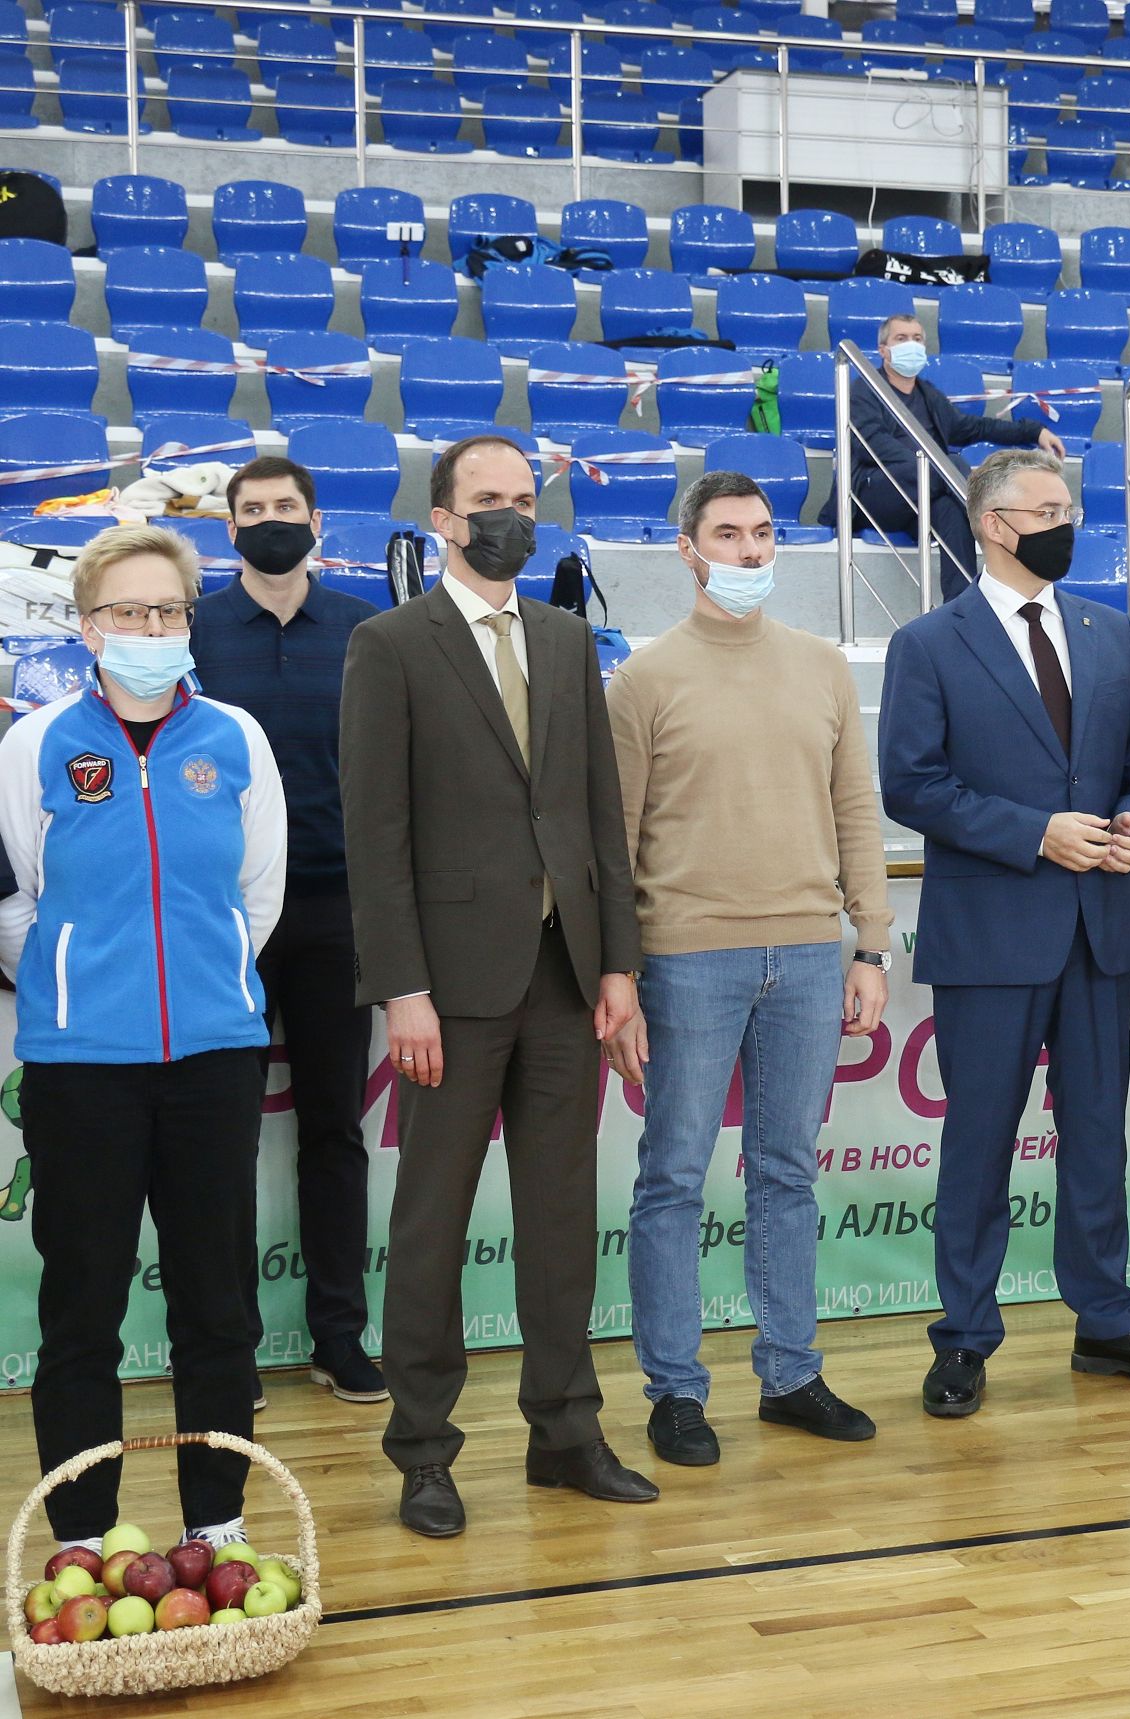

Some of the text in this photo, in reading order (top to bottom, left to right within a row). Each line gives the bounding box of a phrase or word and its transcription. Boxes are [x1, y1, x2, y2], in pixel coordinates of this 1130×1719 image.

[26, 602, 54, 620] FZ
[73, 760, 107, 770] FORWARD
[841, 1147, 862, 1172] В
[869, 1142, 932, 1171] НОС
[879, 1279, 929, 1305] ИЛИ
